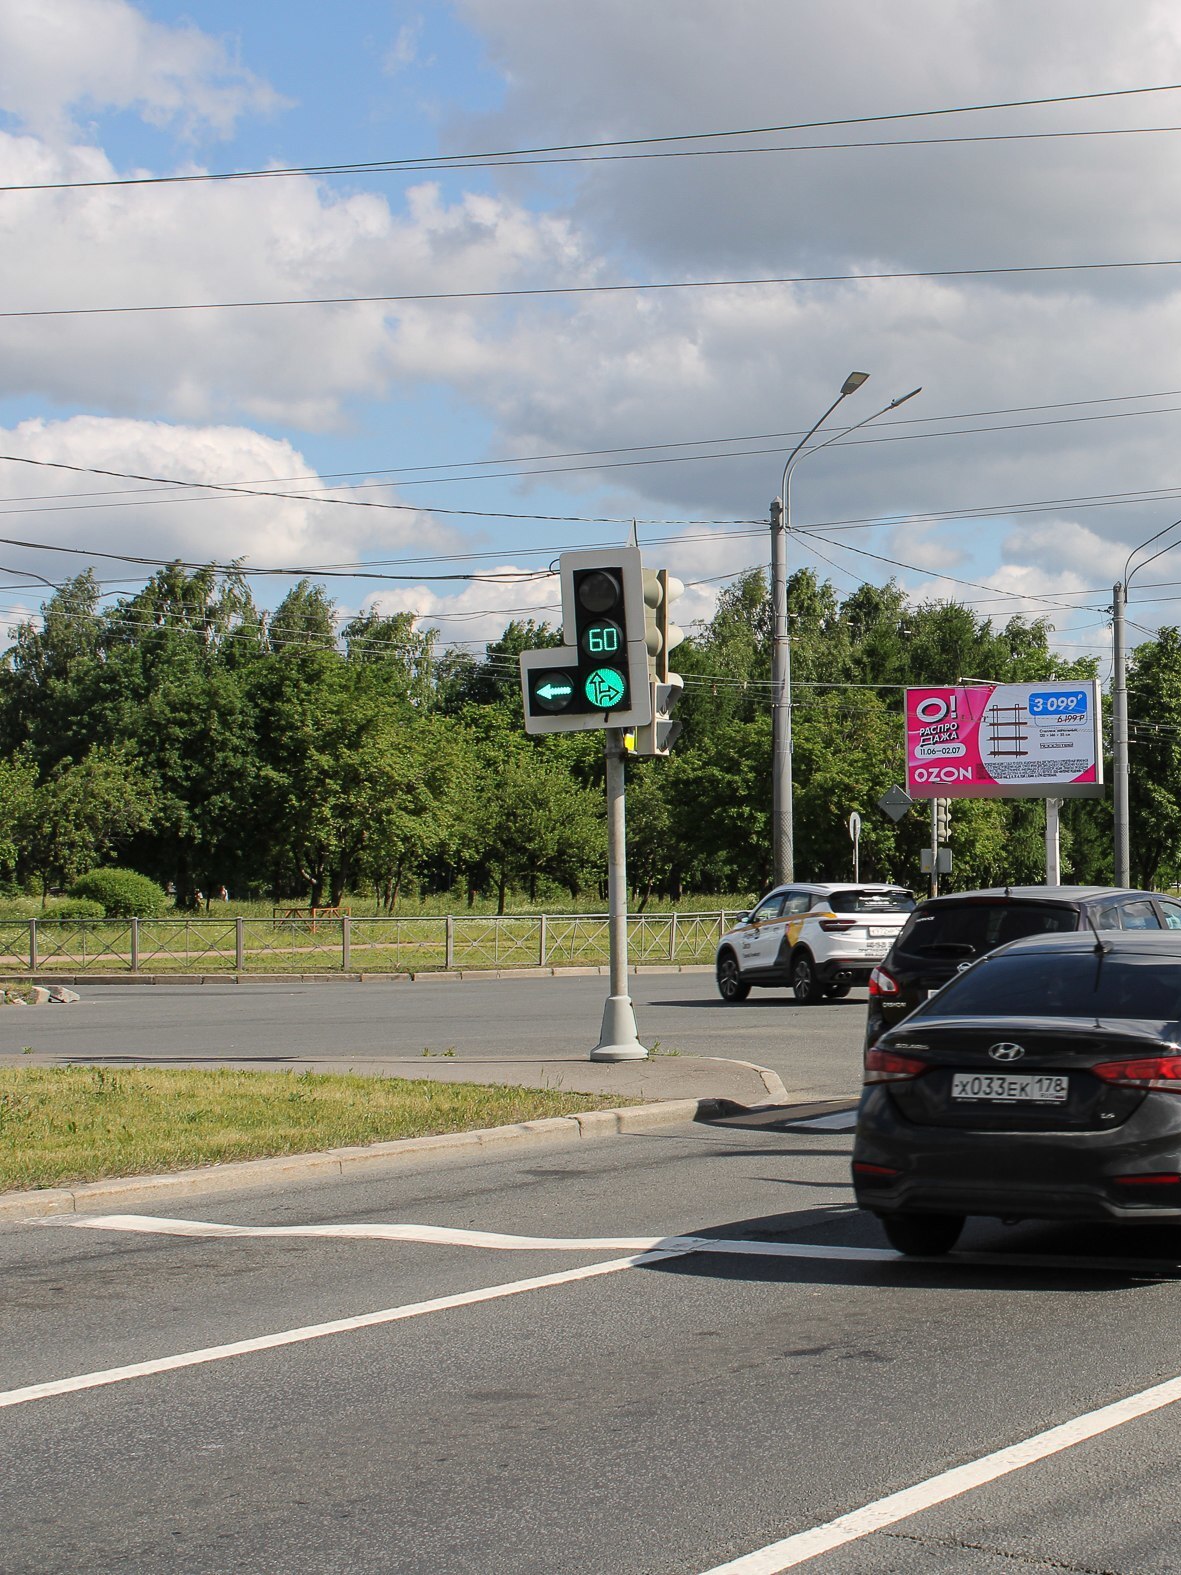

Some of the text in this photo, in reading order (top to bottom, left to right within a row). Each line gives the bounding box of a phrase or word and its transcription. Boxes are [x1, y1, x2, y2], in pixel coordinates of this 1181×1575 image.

[589, 628, 617, 651] 60
[916, 695, 957, 723] О!
[920, 722, 958, 736] РАСПРО
[920, 731, 958, 745] ДАЖА
[914, 766, 972, 783] OZON
[1035, 1077, 1063, 1093] 178
